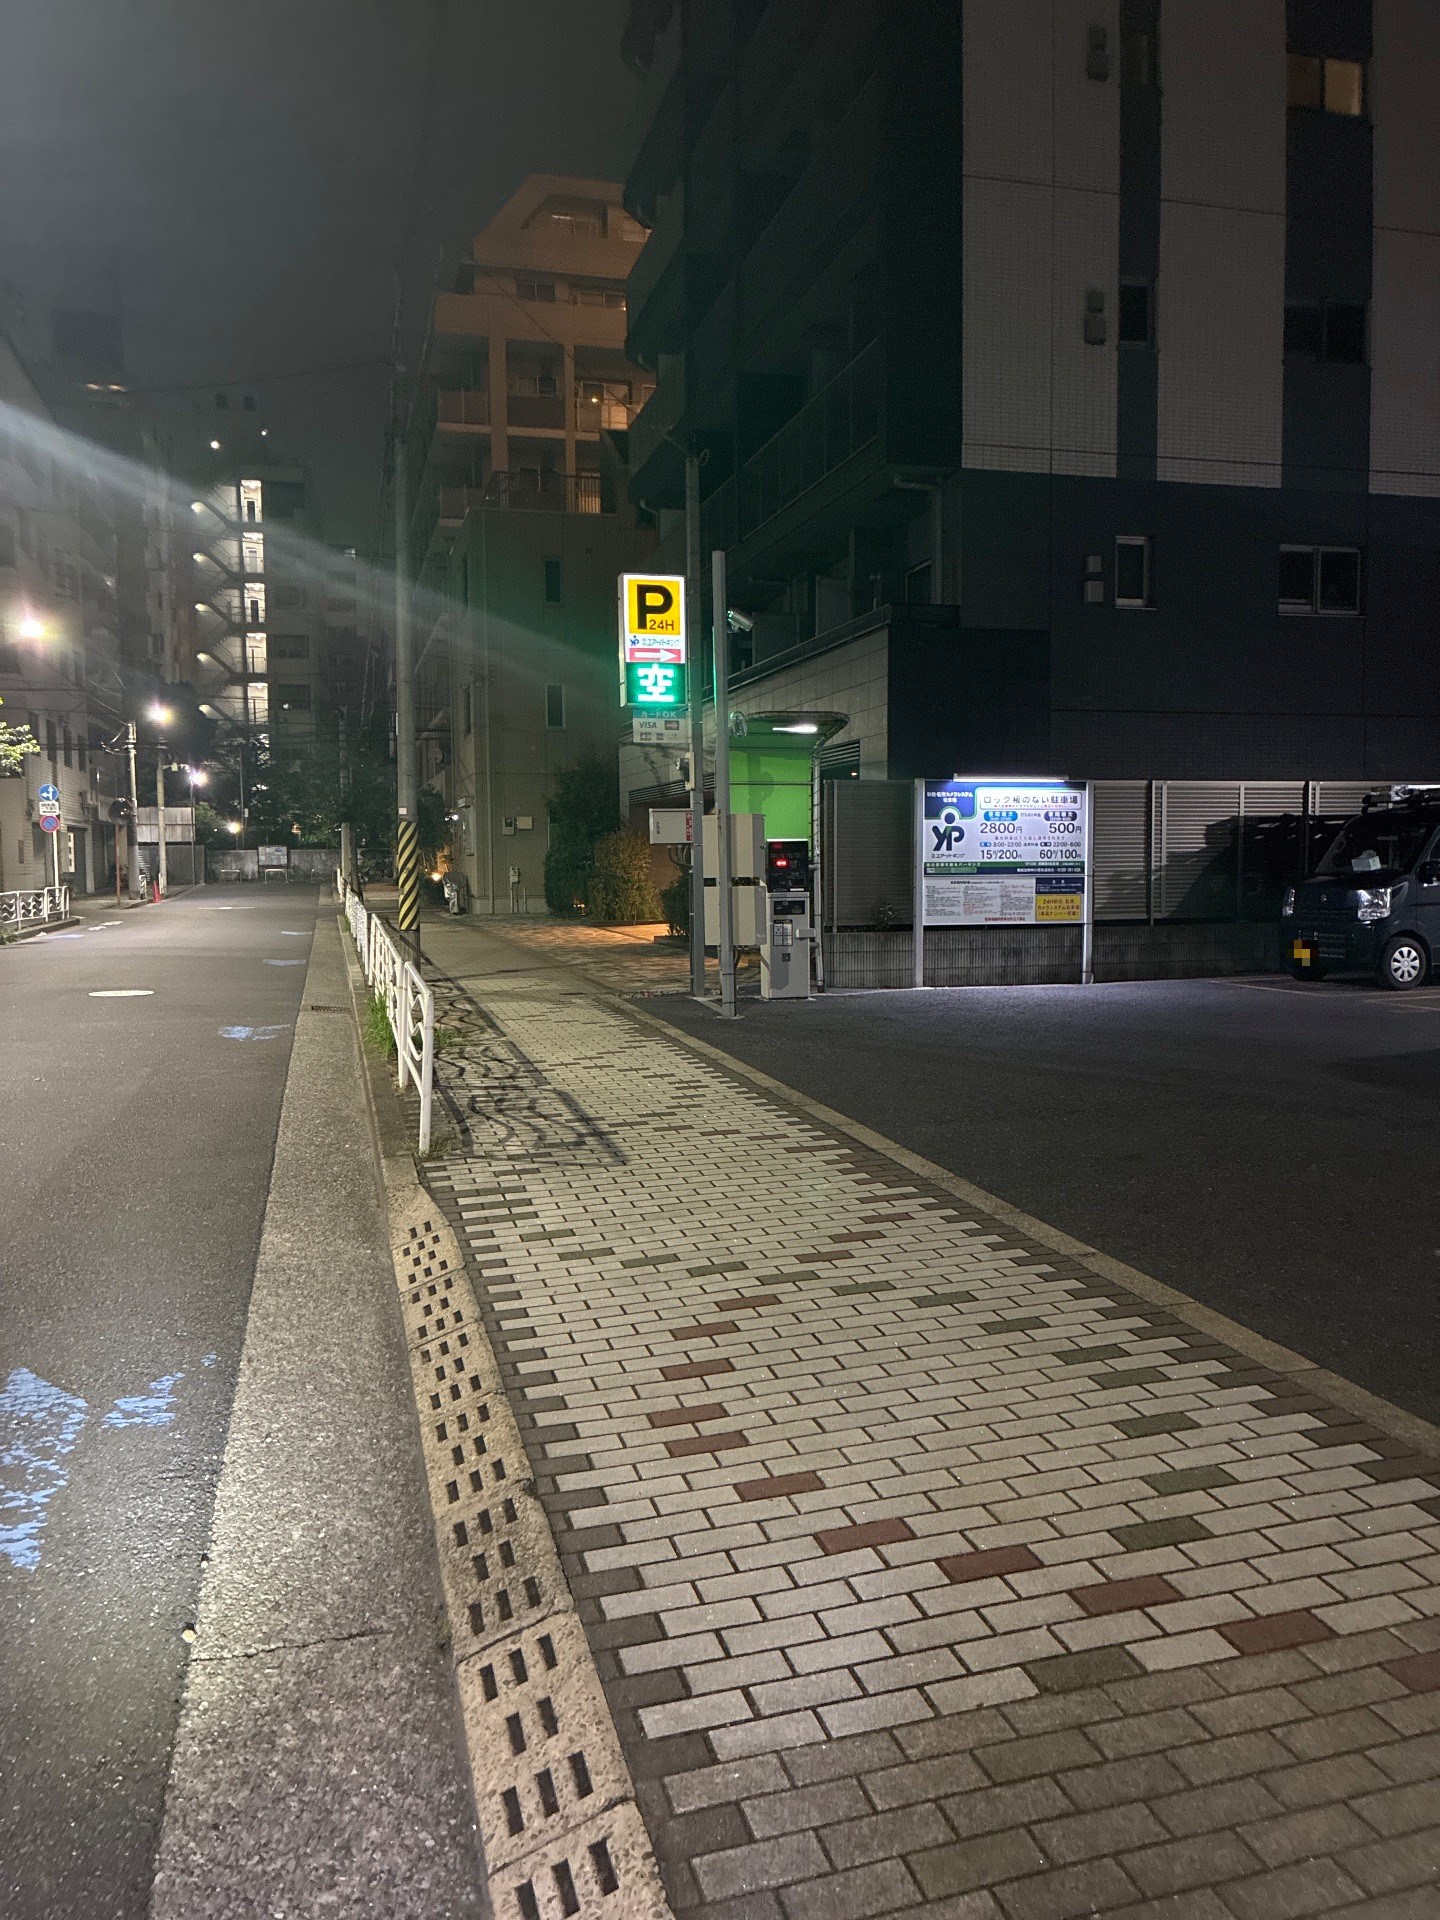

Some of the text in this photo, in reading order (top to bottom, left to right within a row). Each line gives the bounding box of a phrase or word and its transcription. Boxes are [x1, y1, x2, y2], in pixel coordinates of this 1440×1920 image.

[636, 583, 674, 630] P
[649, 619, 675, 631] 24H
[637, 662, 675, 703] 空
[640, 710, 677, 718] カードOK
[639, 721, 658, 729] VISA
[984, 795, 1078, 805] ロック板のない駐車場
[980, 822, 1022, 834] 2800円
[1048, 822, 1082, 834] 500円
